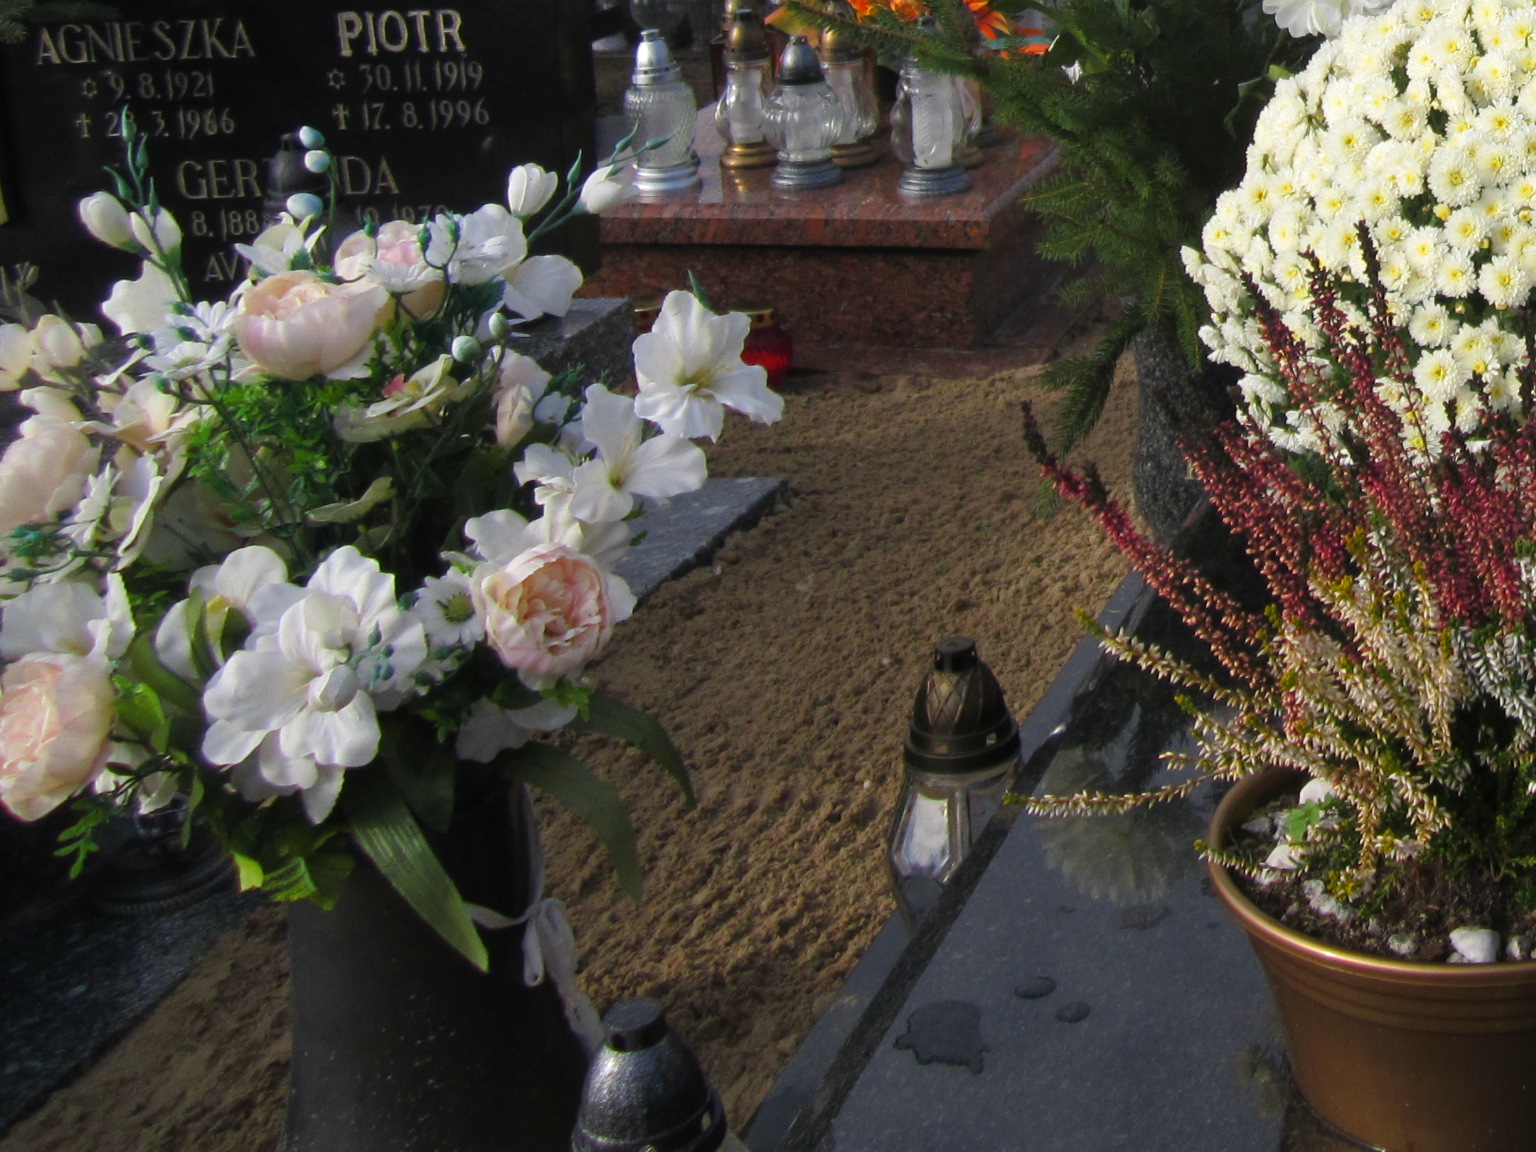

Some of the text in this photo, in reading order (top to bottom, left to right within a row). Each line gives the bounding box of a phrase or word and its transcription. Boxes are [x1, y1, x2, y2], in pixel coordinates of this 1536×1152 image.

[34, 17, 257, 66] AGNIESZKA
[336, 8, 468, 58] PIOTR
[176, 156, 400, 199] GERDA
